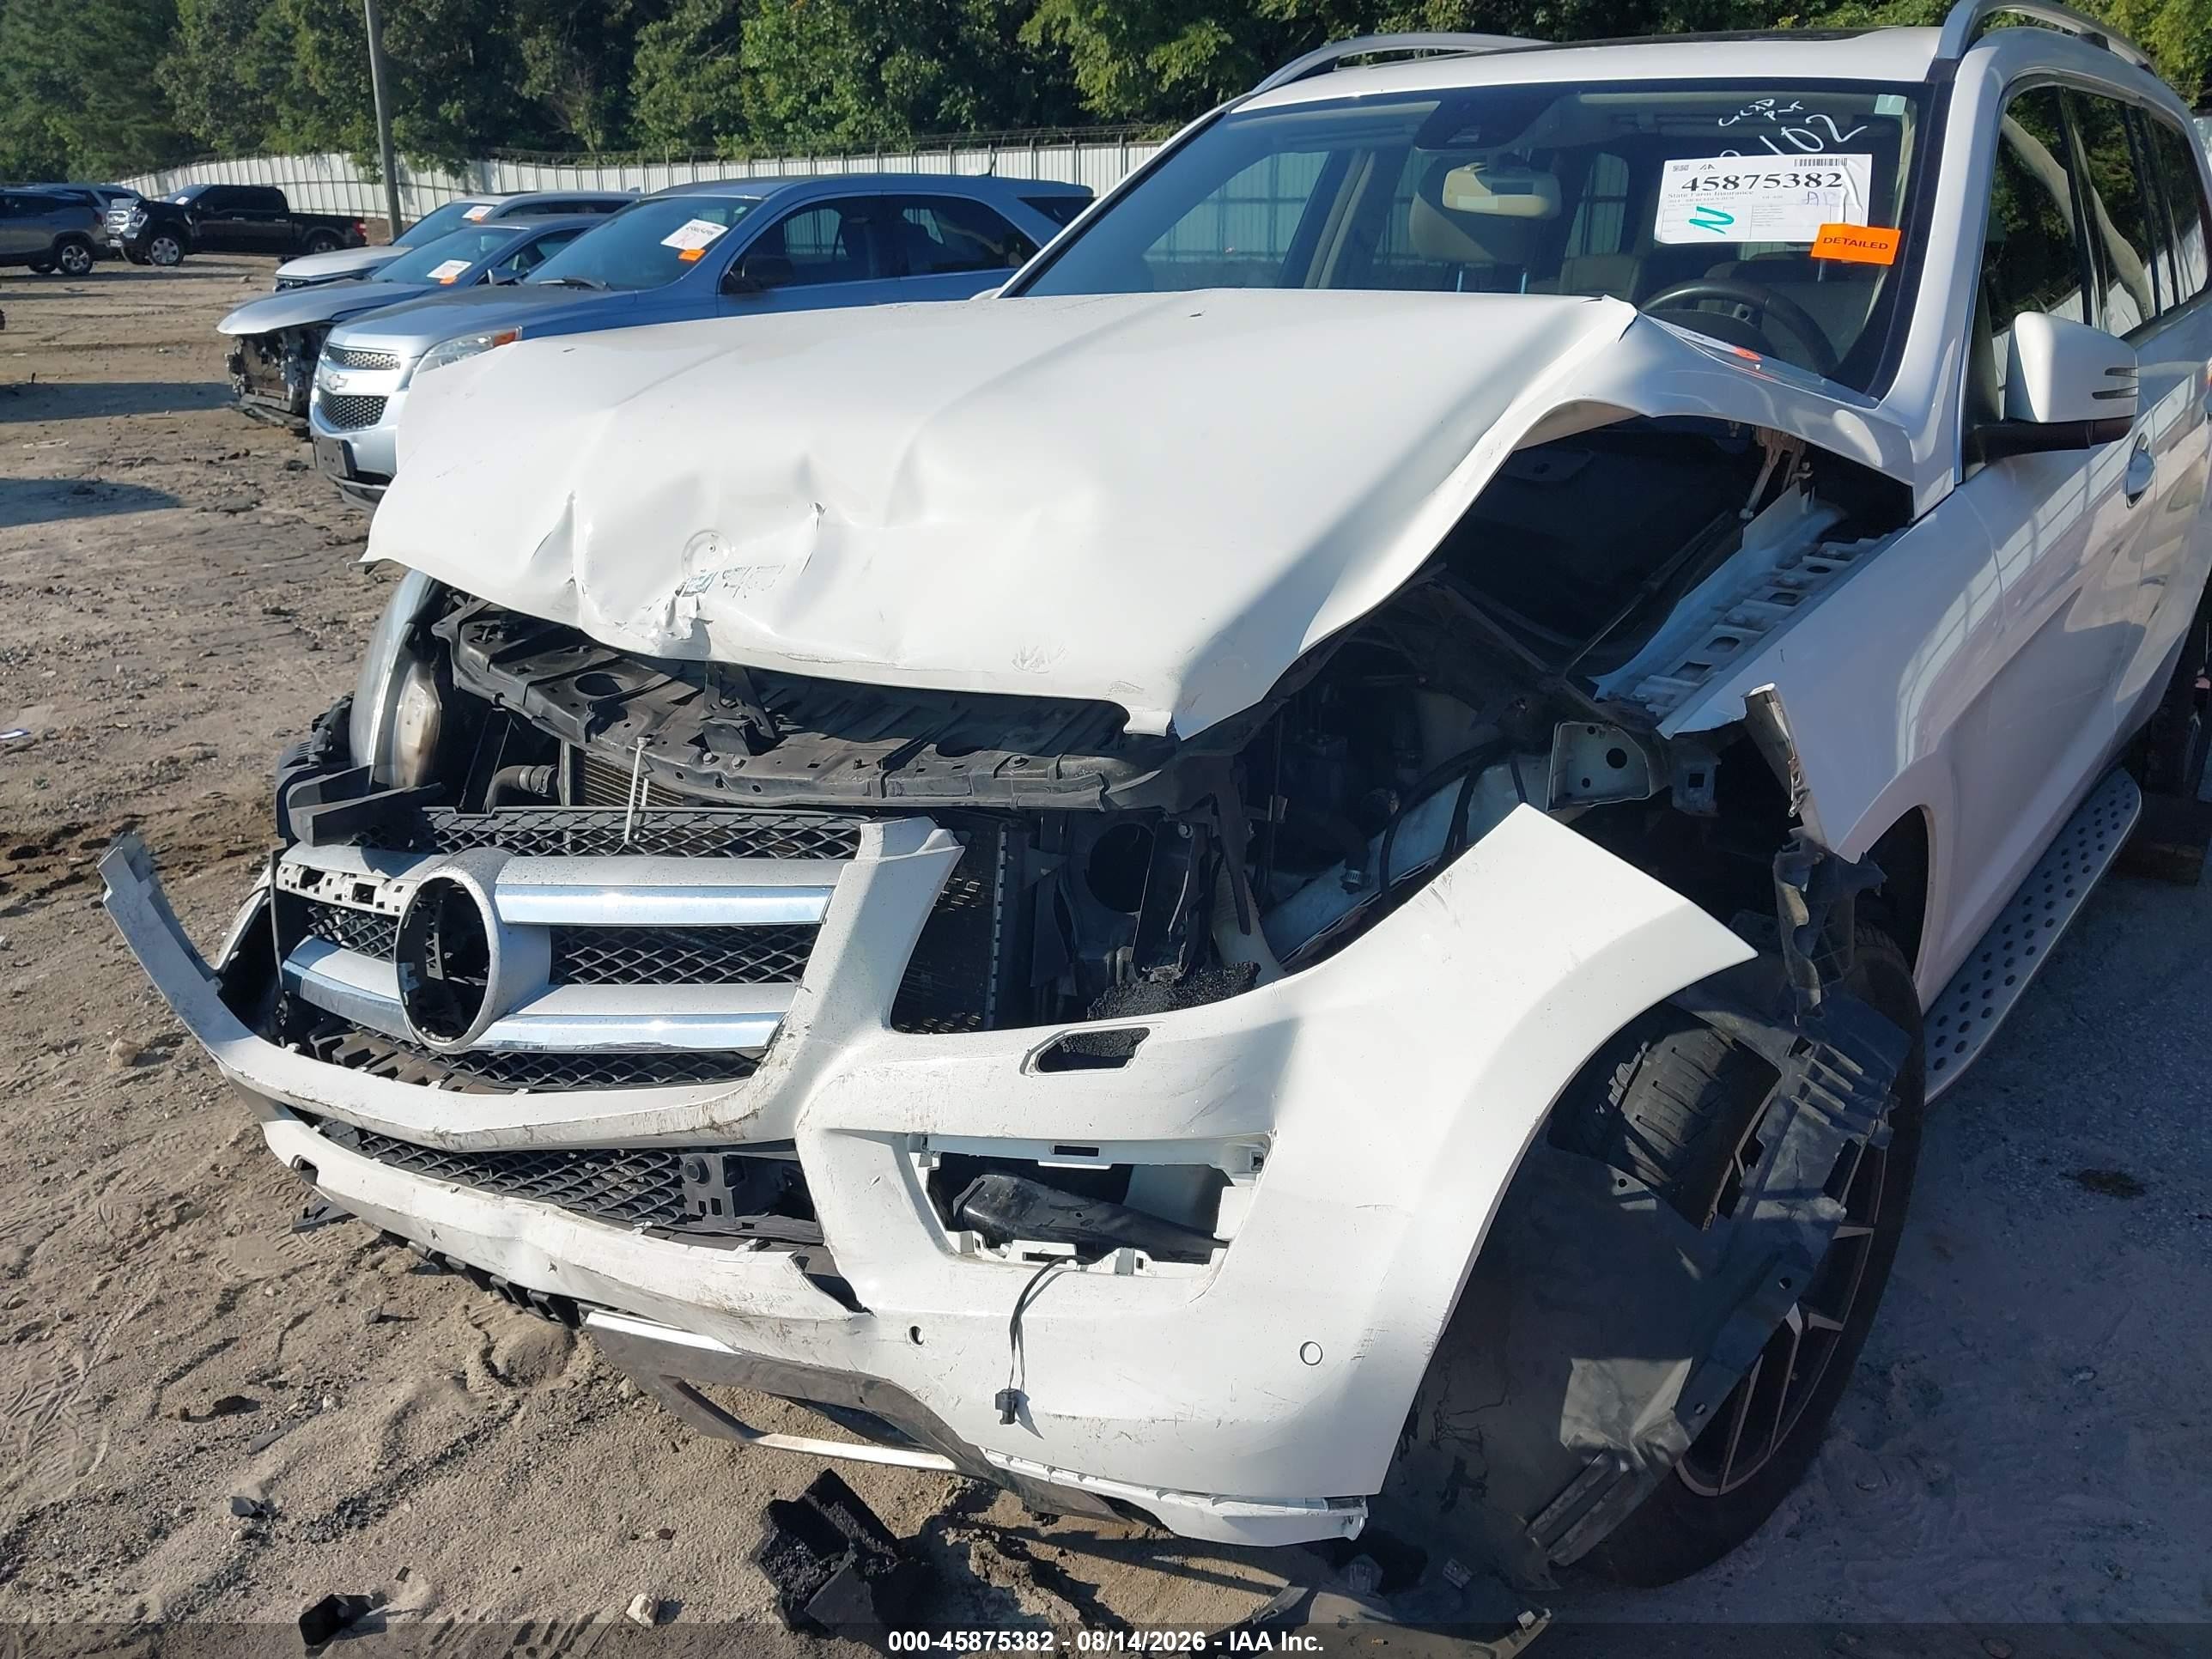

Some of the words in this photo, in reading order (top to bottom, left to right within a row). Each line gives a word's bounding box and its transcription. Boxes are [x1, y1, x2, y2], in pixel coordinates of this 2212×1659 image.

[1719, 113, 1869, 158] 102
[1681, 173, 1843, 191] 45875382
[1823, 237, 1889, 250] DETAILED
